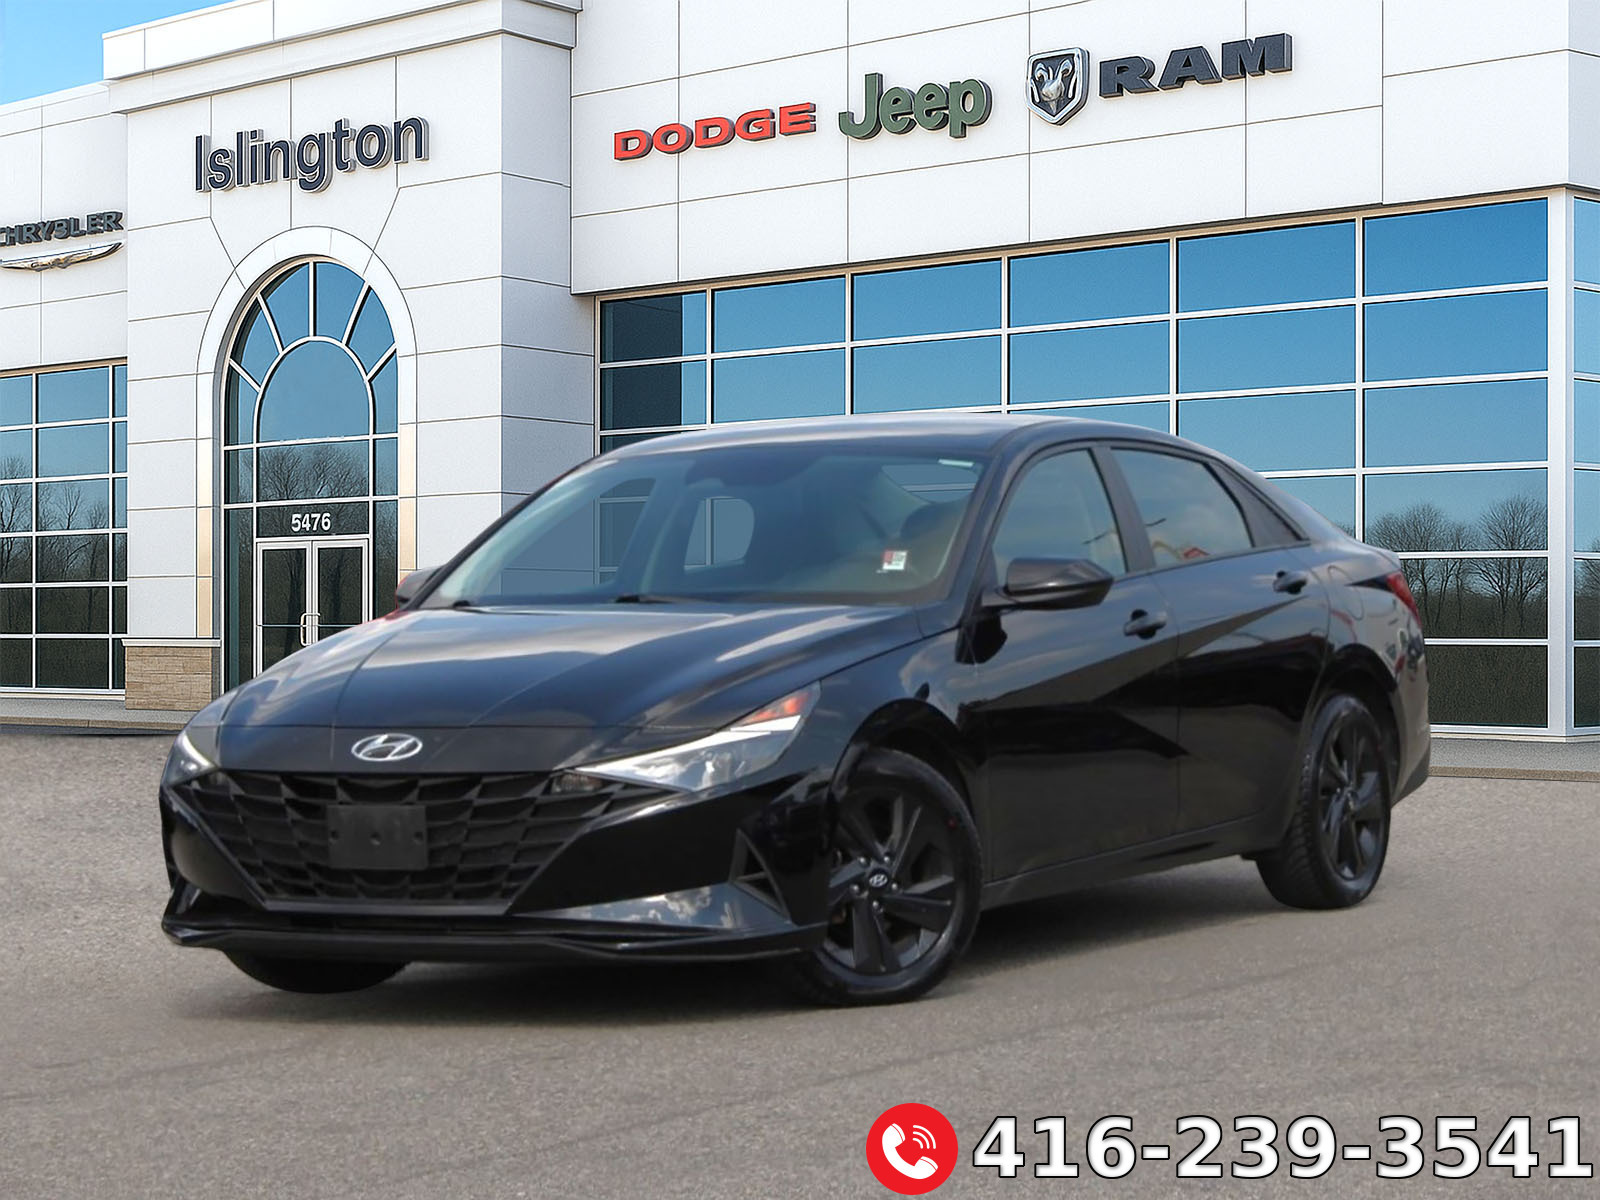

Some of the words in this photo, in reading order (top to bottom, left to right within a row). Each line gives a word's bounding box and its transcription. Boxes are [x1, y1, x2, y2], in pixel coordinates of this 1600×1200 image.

[614, 102, 817, 161] DODGE
[839, 72, 992, 139] Jeep
[1100, 33, 1293, 97] RAM
[195, 116, 429, 193] Islington
[291, 512, 331, 532] 5476
